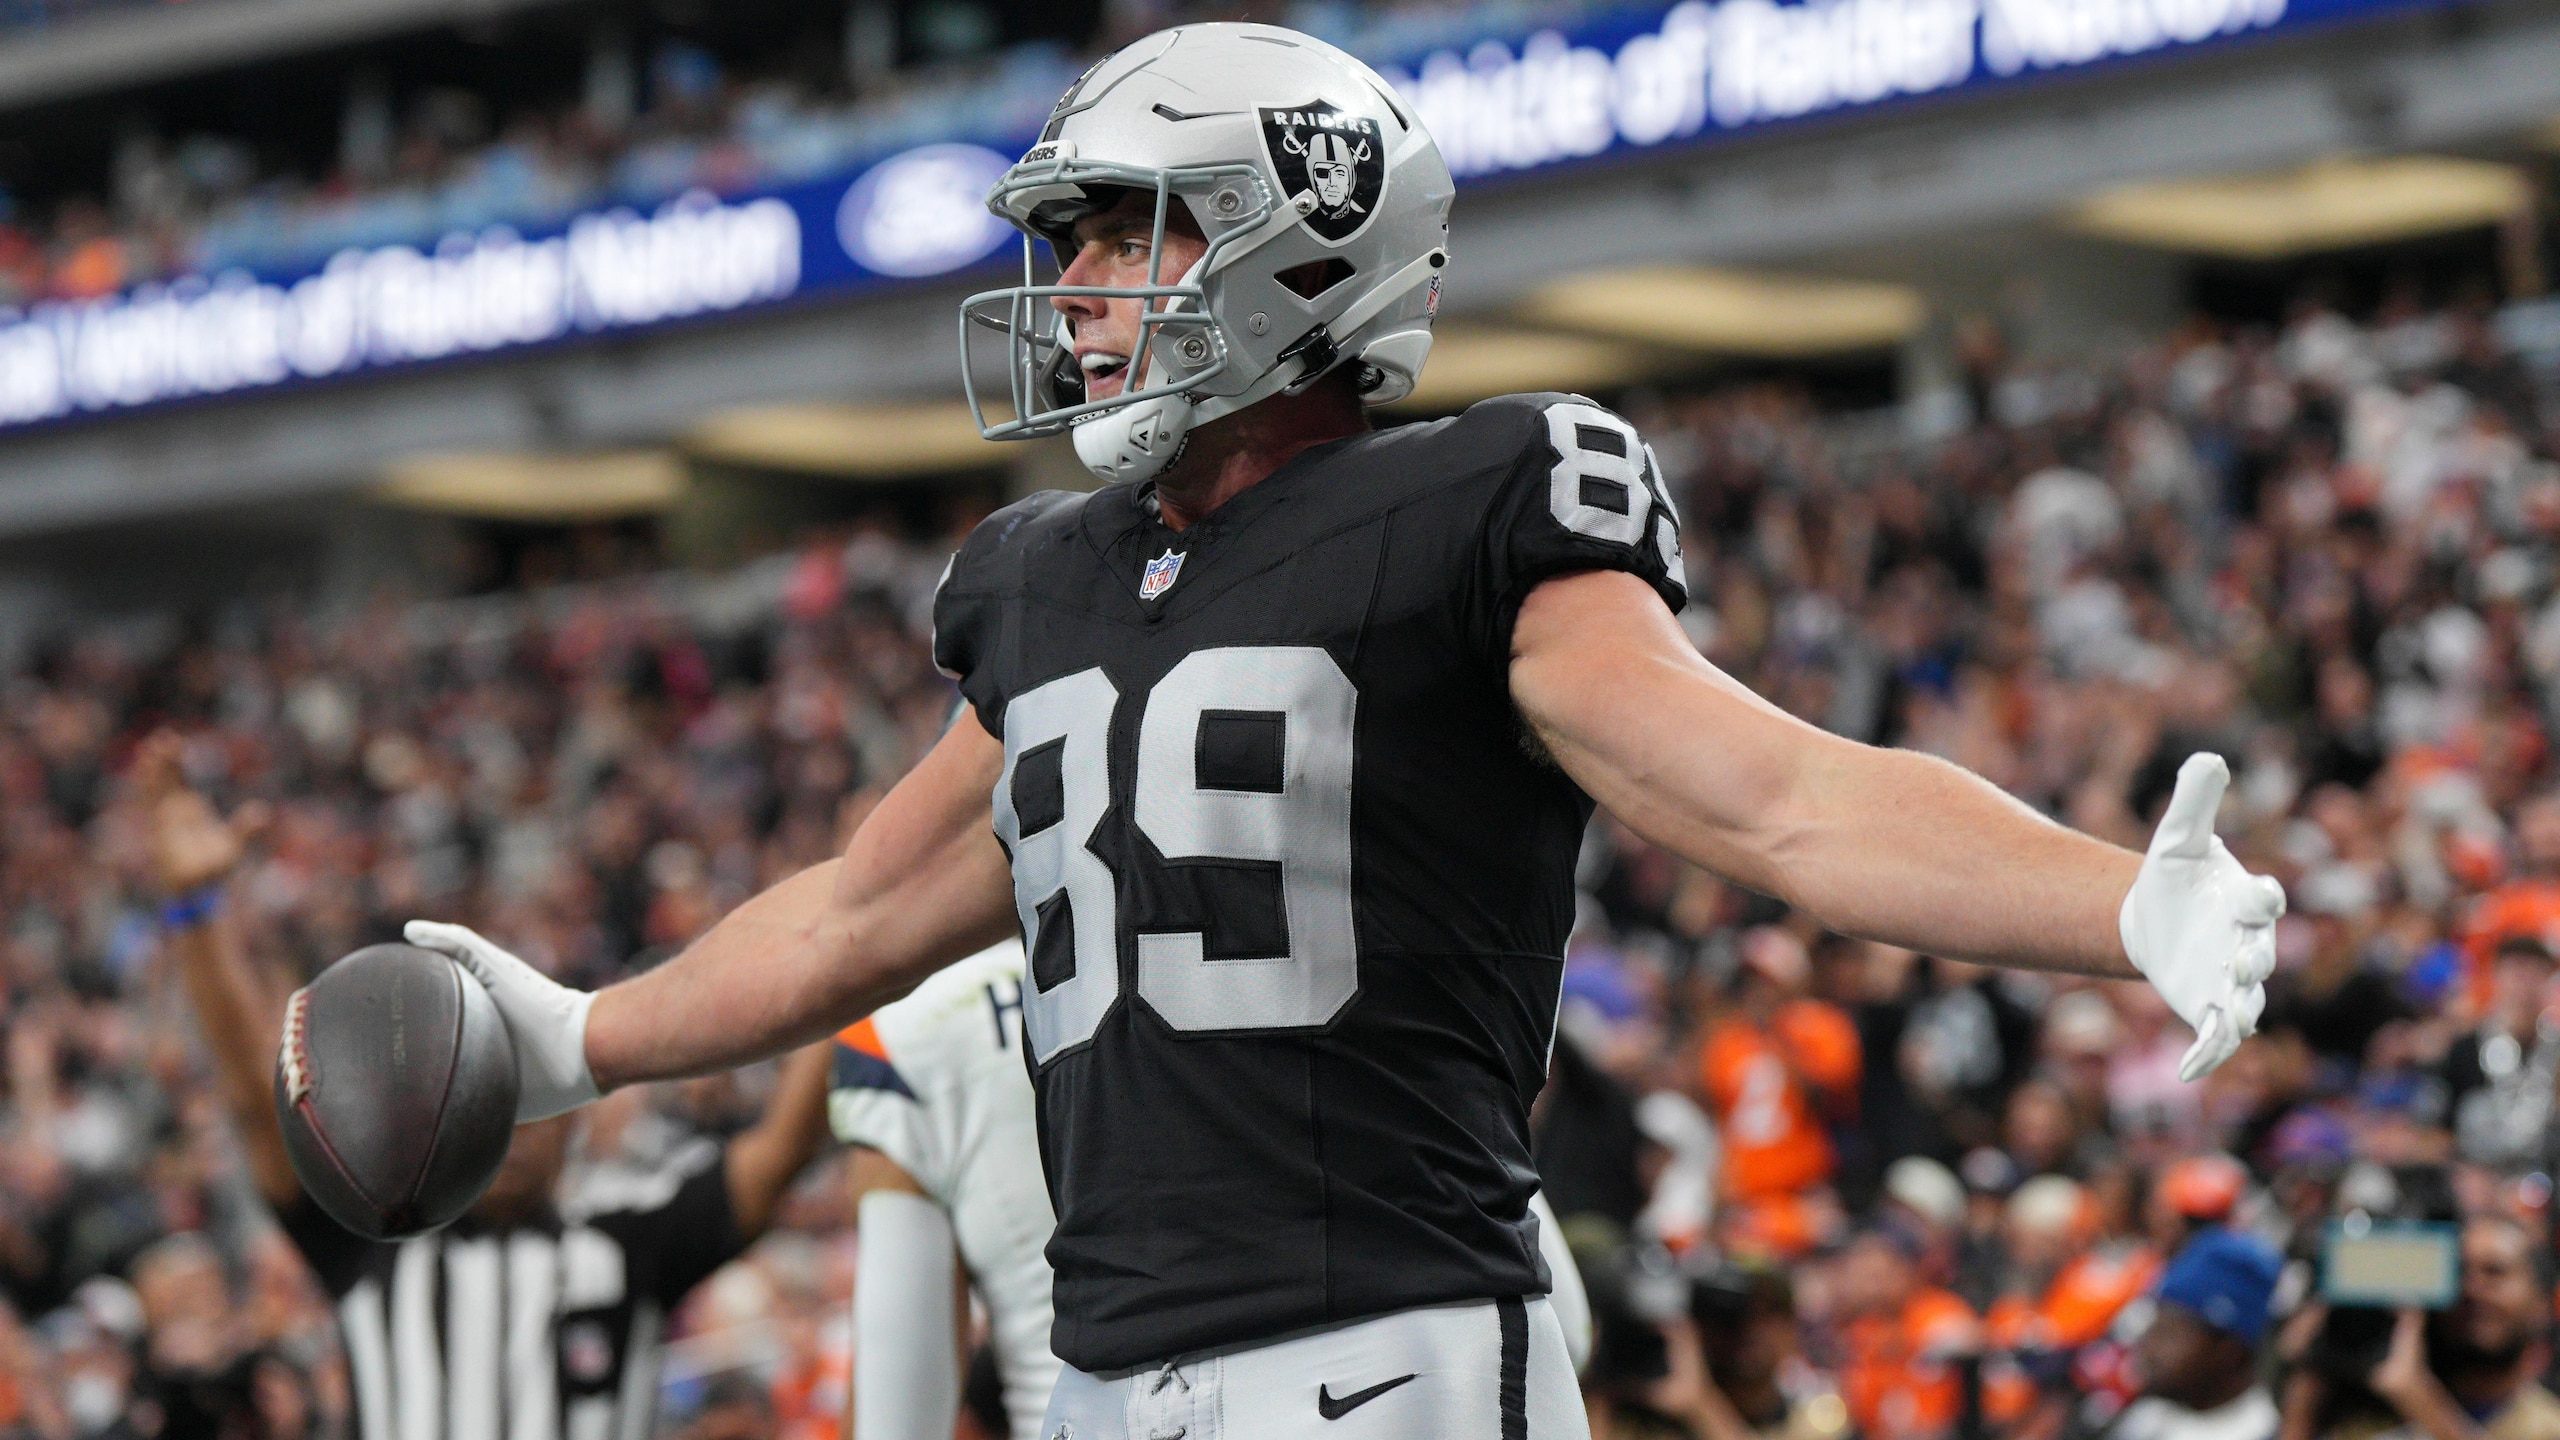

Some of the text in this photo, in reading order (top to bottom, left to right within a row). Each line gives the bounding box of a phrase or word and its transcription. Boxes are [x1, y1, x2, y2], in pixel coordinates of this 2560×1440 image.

[1273, 111, 1371, 135] RAIDERS
[1614, 2, 1706, 146] of
[1708, 0, 1974, 128] Raider
[1984, 0, 2287, 78] Natio
[364, 226, 568, 365] Raider
[570, 190, 800, 332] Nation
[1145, 569, 1171, 592] NFL
[992, 646, 1358, 1065] 89
